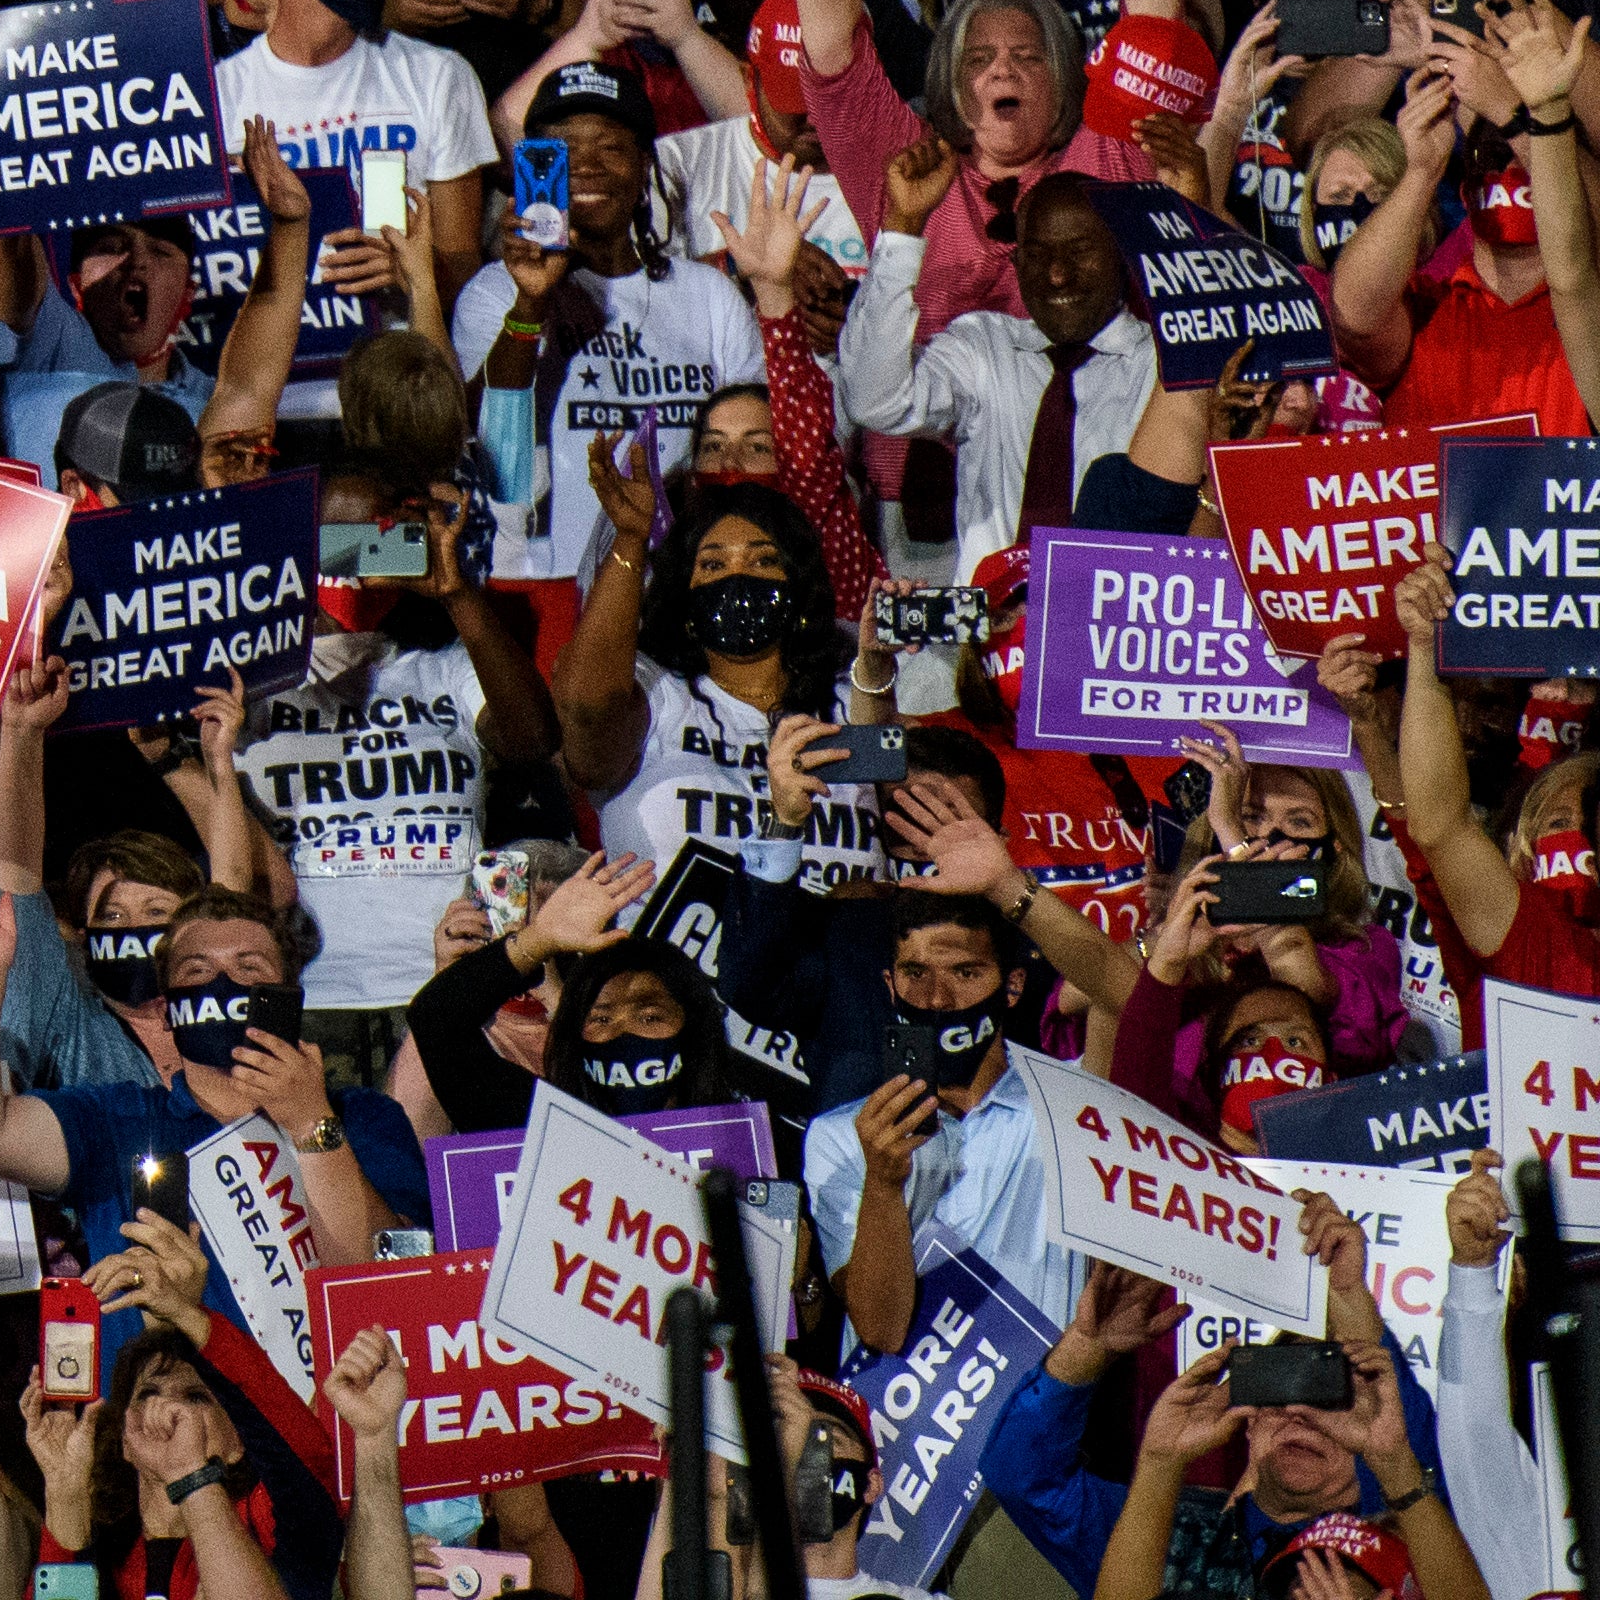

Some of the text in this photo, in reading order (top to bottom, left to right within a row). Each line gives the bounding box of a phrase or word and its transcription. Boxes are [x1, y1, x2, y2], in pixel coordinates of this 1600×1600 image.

[6, 34, 119, 81] MAKE
[87, 132, 212, 184] AGAIN
[1139, 249, 1302, 299] AMERICA
[558, 321, 644, 361] Black
[1159, 300, 1322, 346] GREAT AGAIN
[611, 359, 715, 398] Voices
[575, 408, 621, 426] FOR
[1307, 463, 1439, 510] MAKE
[134, 523, 242, 576] MAKE
[61, 558, 306, 648] AMERICA
[1260, 584, 1385, 623] GREAT
[1454, 593, 1600, 629] GREAT
[202, 615, 304, 675] AGAIN
[1089, 624, 1250, 676] VOICES
[269, 694, 459, 736] BLACKS
[1088, 685, 1304, 718] FOR TRUMP
[342, 731, 410, 756] FOR
[265, 749, 477, 808] TRUMP
[313, 823, 462, 848] TRUMP
[320, 846, 453, 862] PENCE
[1220, 1059, 1322, 1089] MAGA
[1074, 1105, 1288, 1196] 4 MORE
[558, 1178, 592, 1224] 4
[1088, 1156, 1281, 1261] YEARS!
[479, 1469, 526, 1485] 2020
